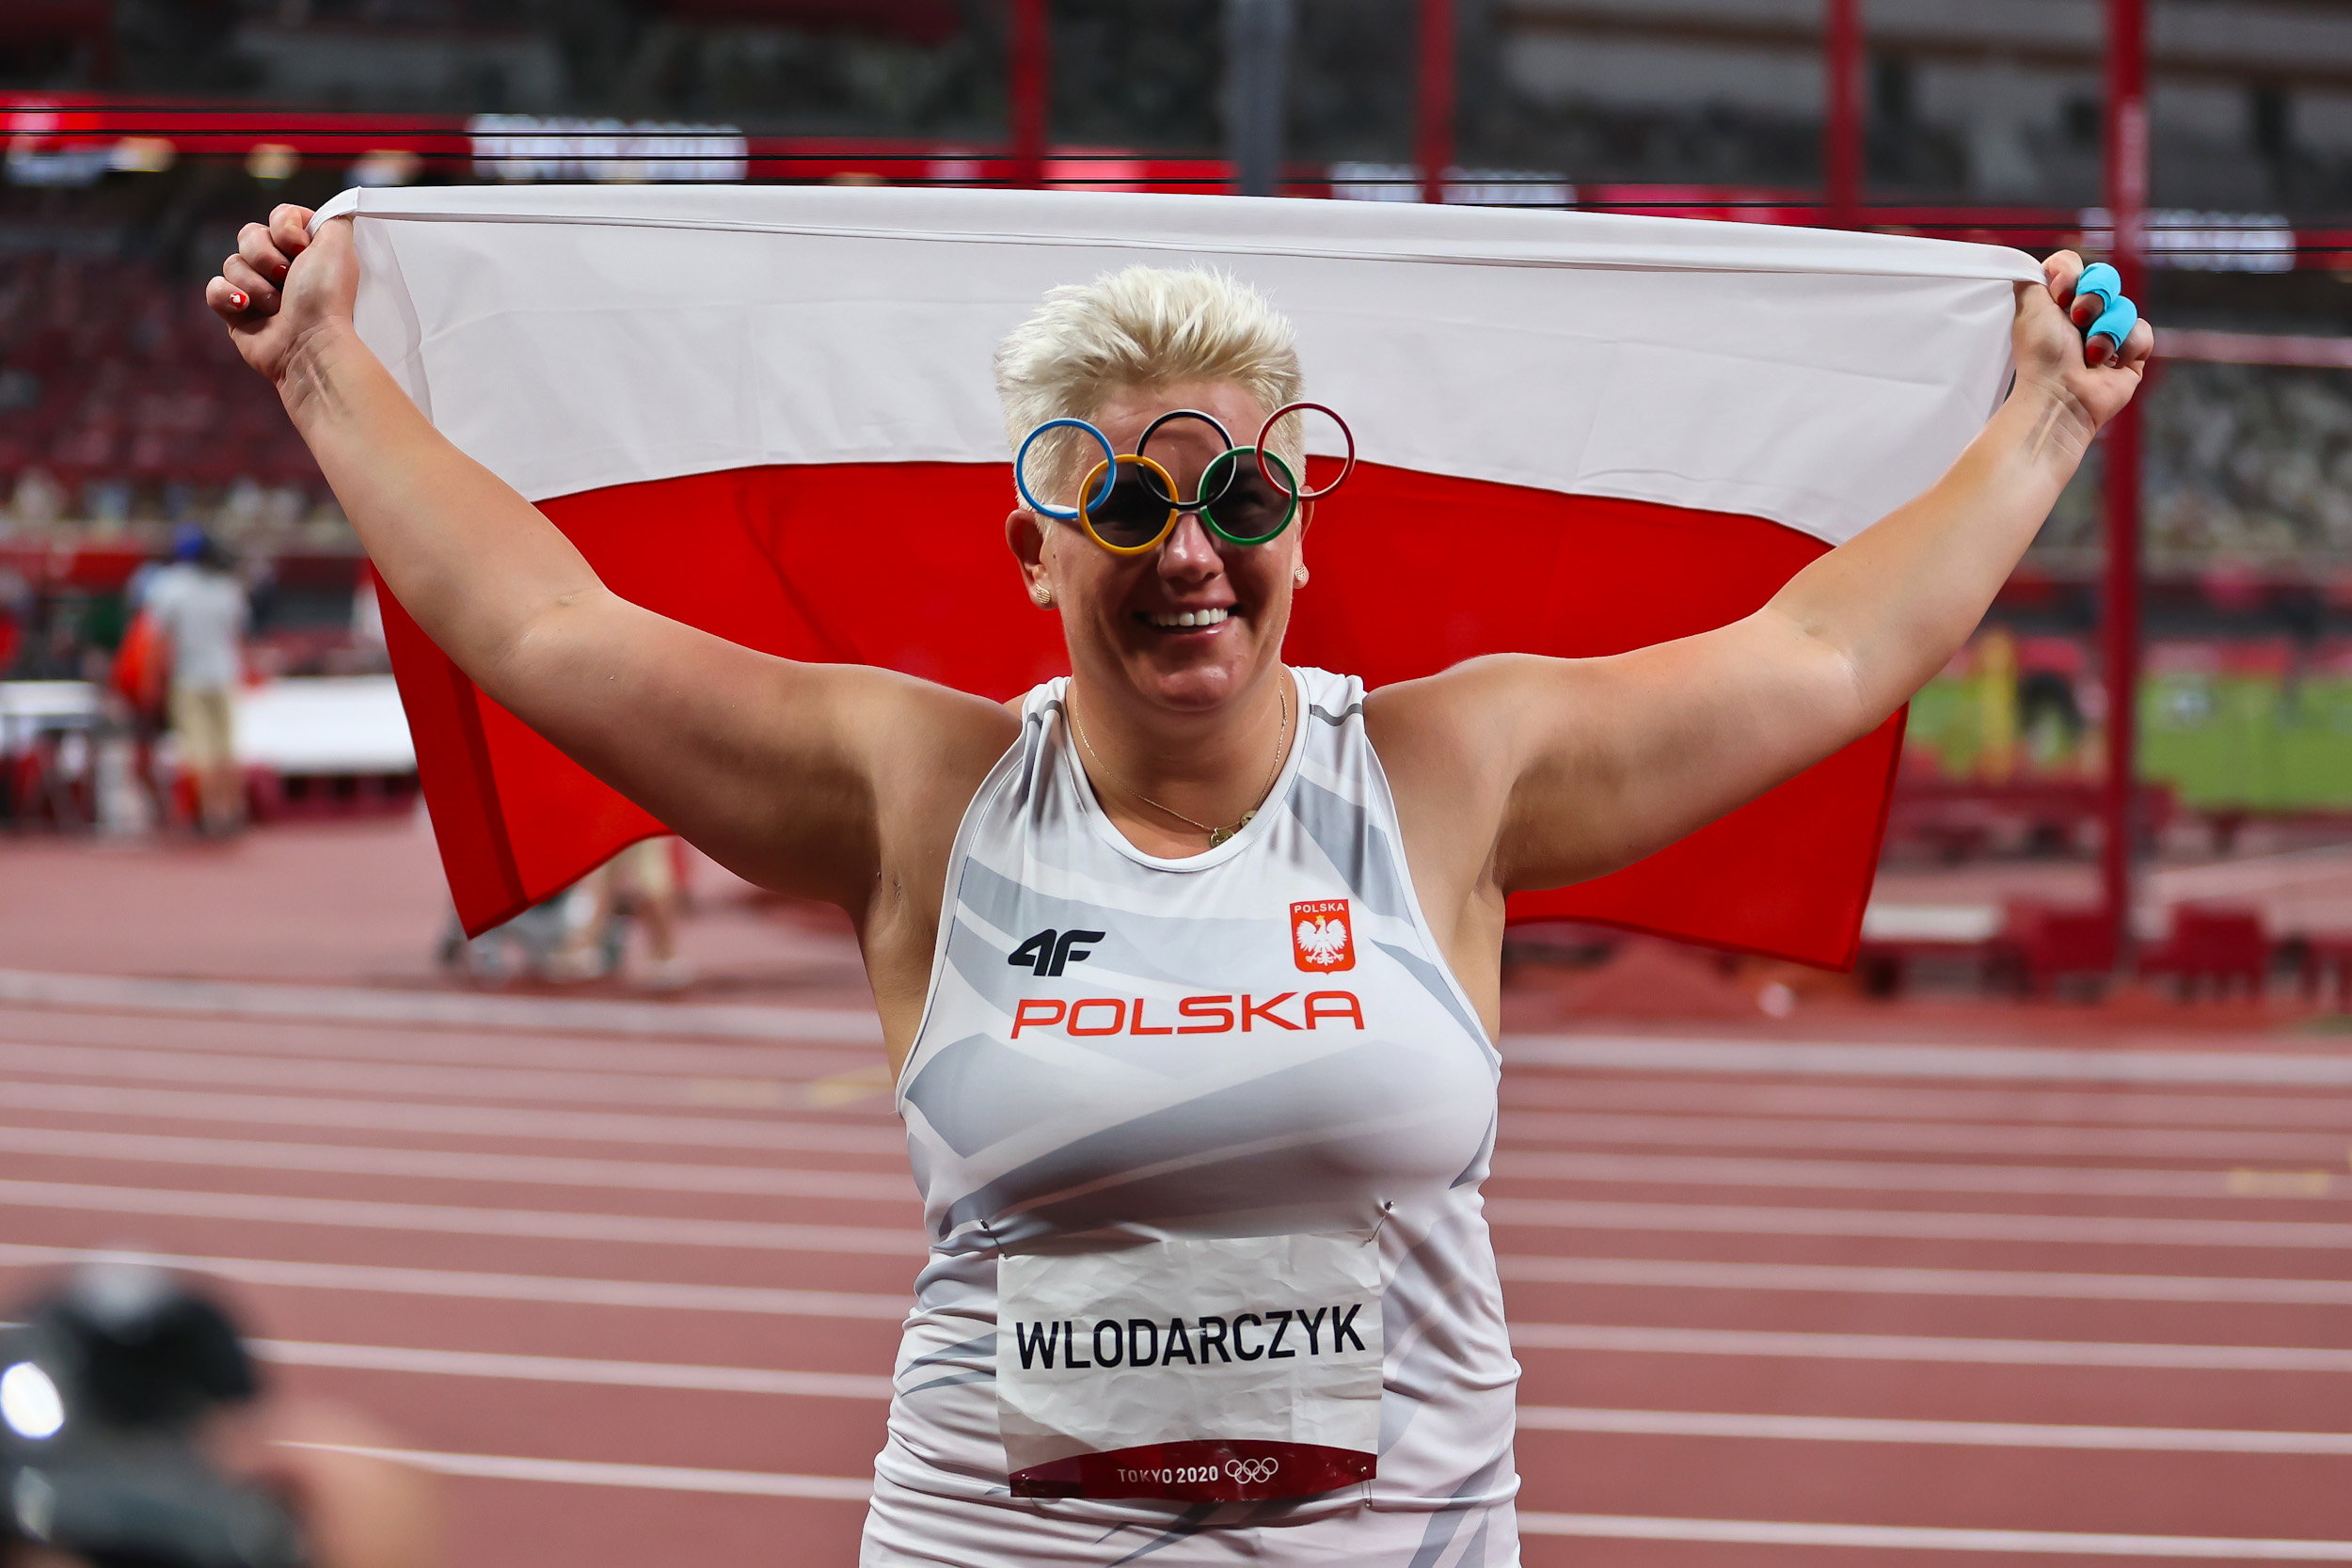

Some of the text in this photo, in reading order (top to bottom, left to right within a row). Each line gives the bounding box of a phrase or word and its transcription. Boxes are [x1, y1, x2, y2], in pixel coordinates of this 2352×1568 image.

[1294, 902, 1345, 913] POLSKA
[1008, 928, 1106, 977] 4F
[1010, 990, 1365, 1039] POLSKA
[1015, 1303, 1366, 1370] WLODARCZYK
[1117, 1465, 1219, 1484] TOKYO 2020
